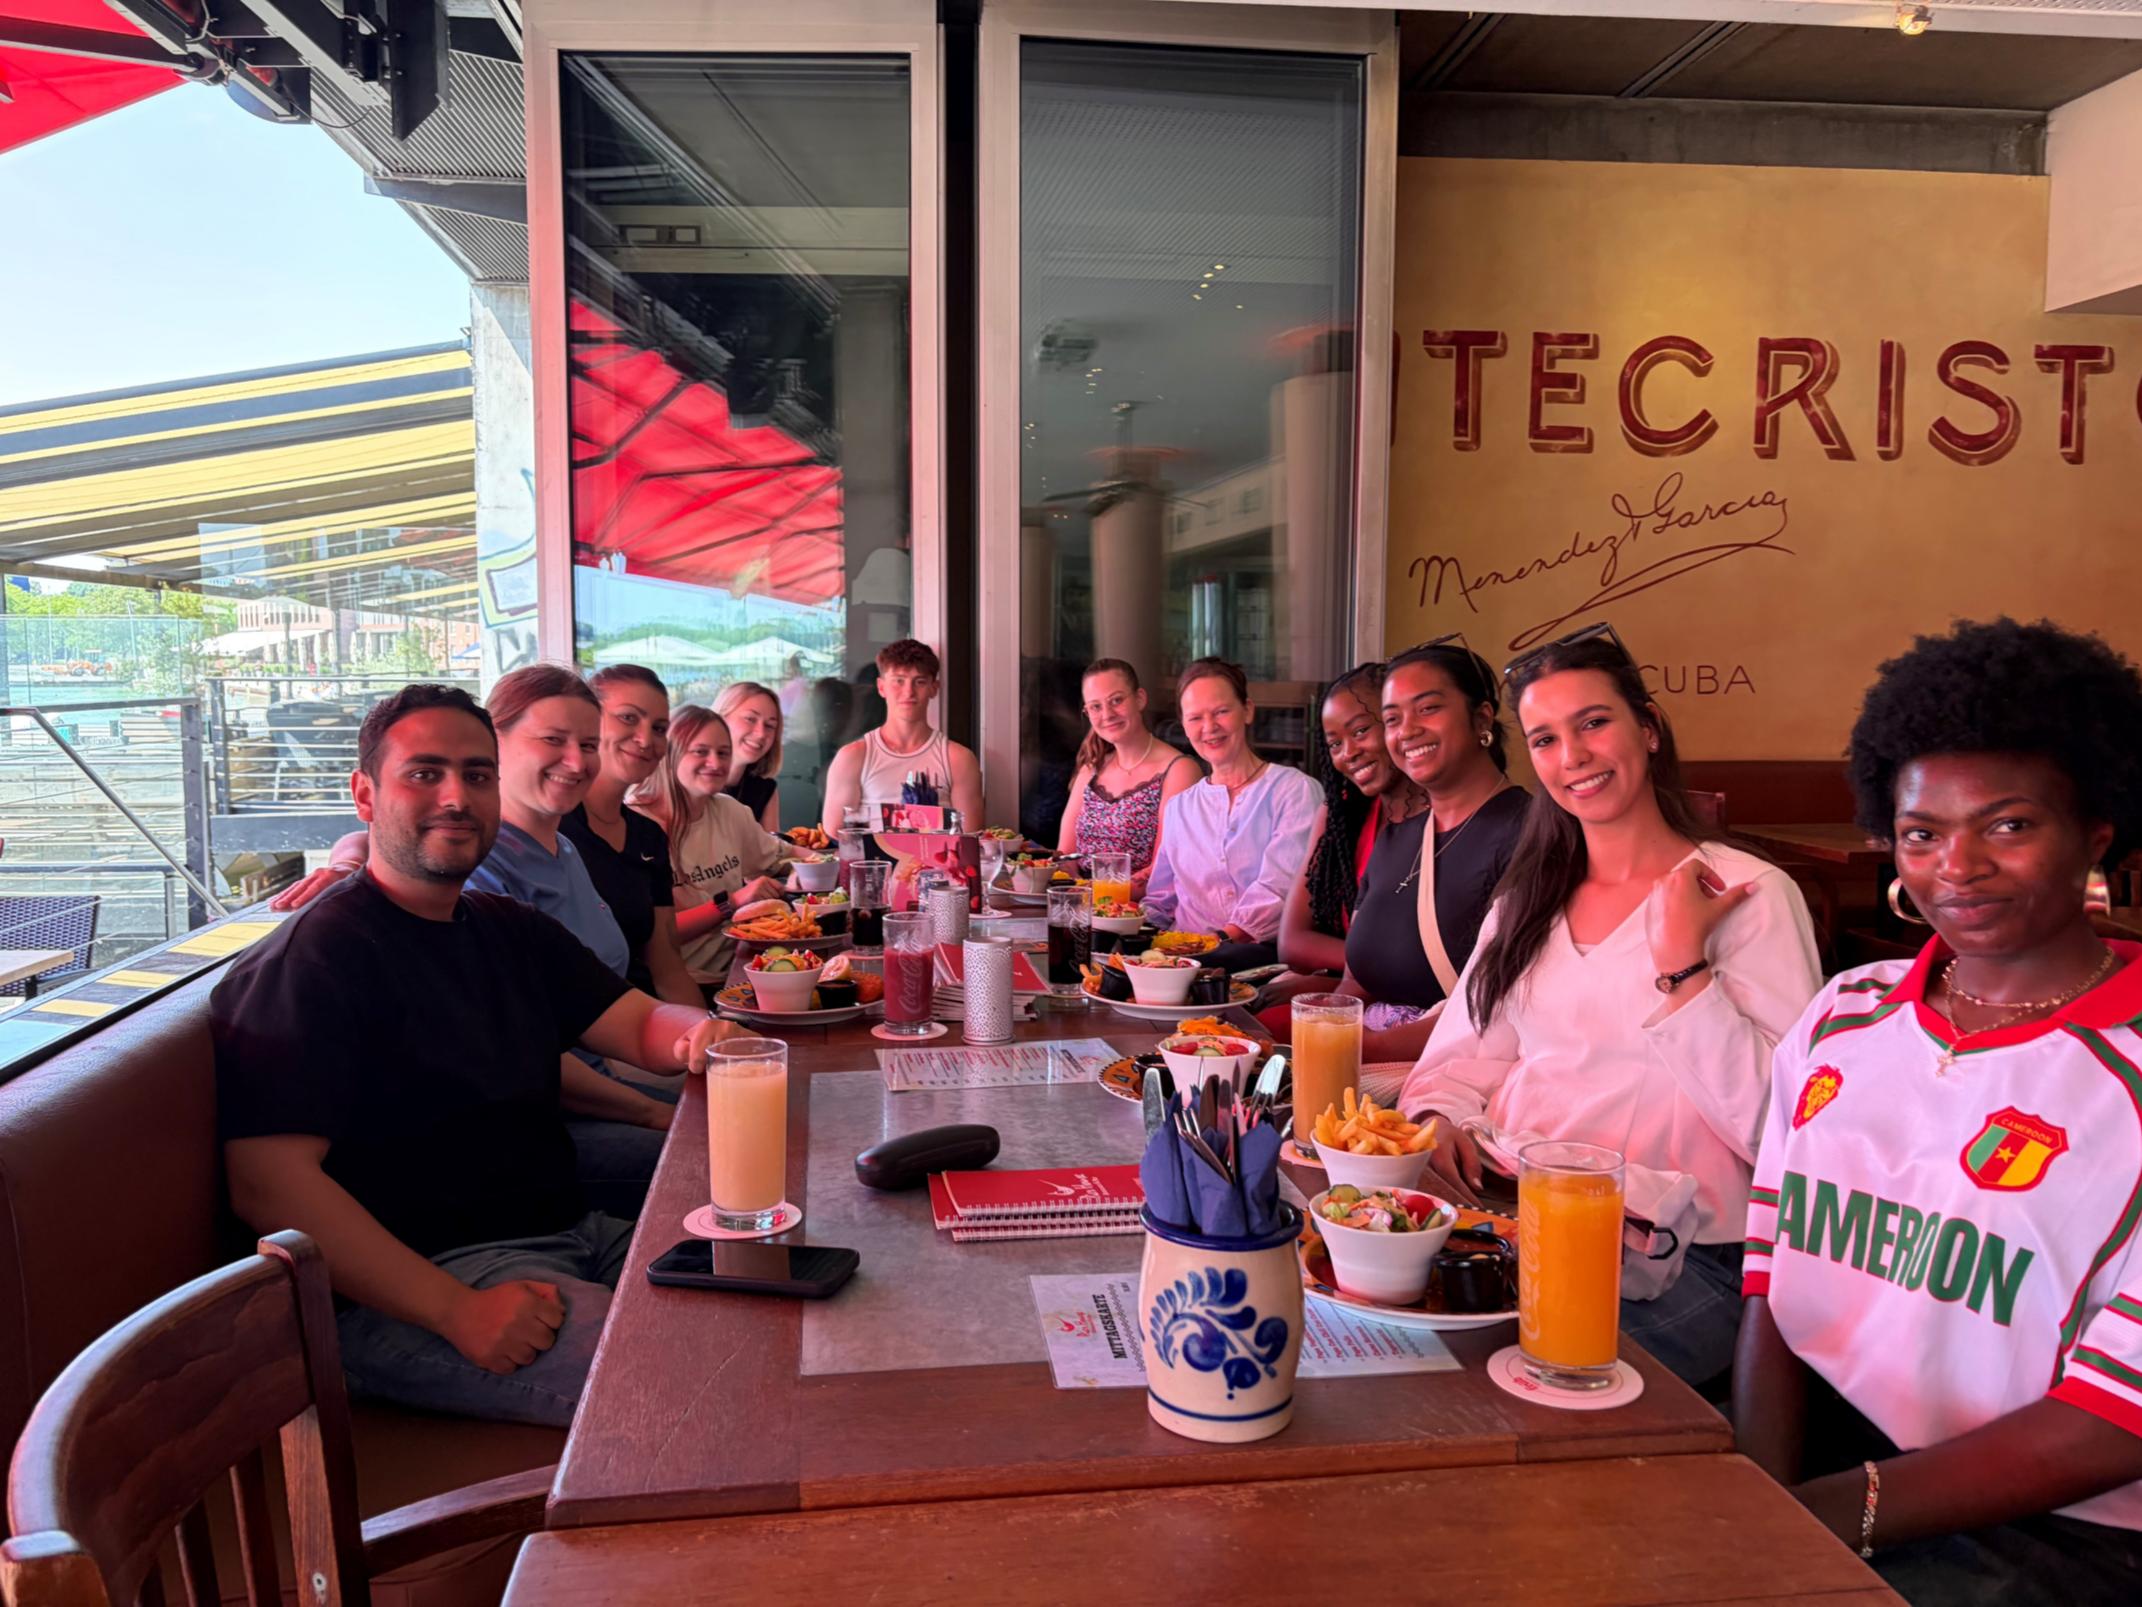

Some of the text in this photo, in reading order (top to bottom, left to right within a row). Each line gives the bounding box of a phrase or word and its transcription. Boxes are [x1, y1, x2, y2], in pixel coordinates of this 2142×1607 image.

[1390, 329, 2142, 467] TECRIST
[1408, 531, 1618, 614] Menendez
[2000, 1117, 2054, 1145] CAMEROON
[1774, 1169, 2036, 1328] AMEROON
[1092, 1293, 1128, 1359] MITTAGSKARTE
